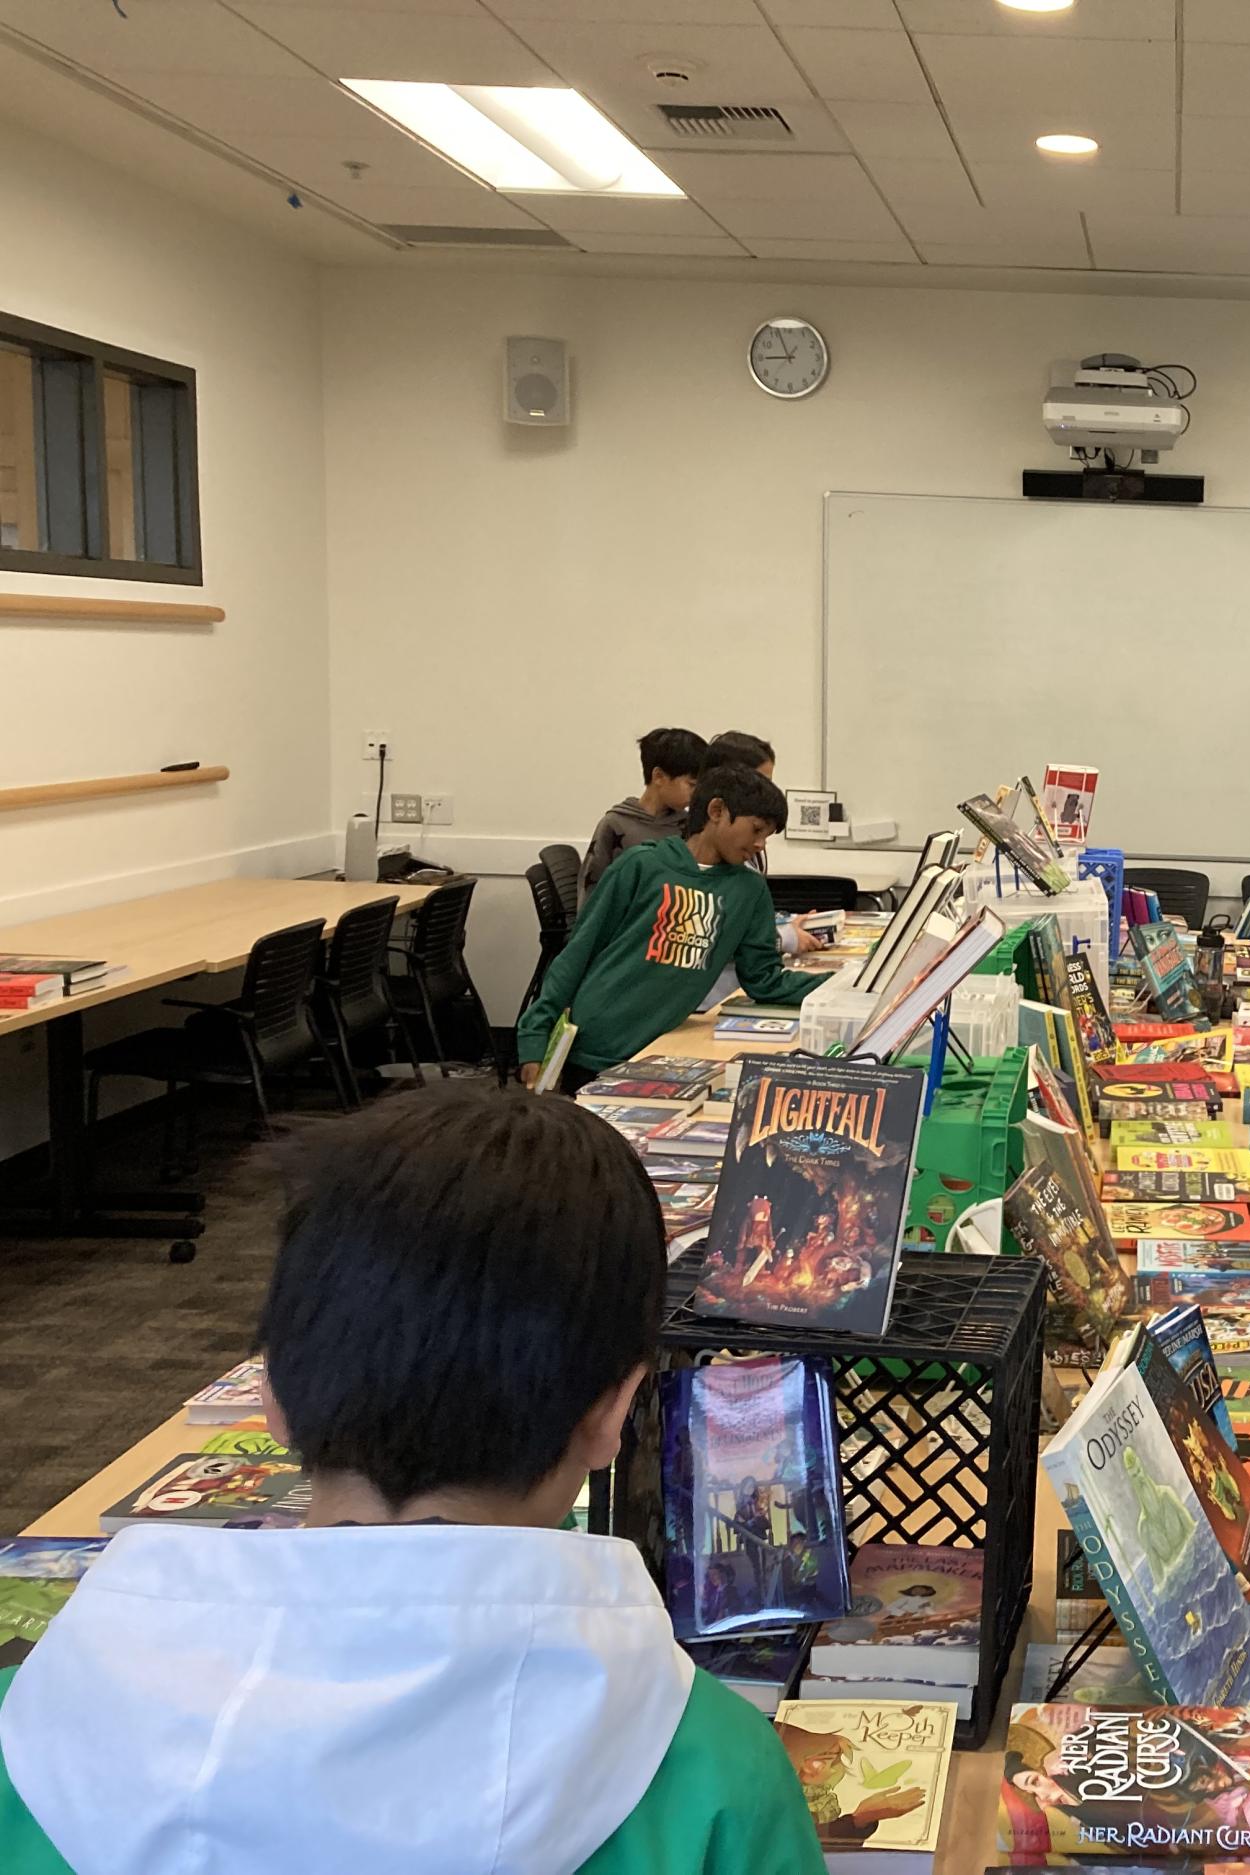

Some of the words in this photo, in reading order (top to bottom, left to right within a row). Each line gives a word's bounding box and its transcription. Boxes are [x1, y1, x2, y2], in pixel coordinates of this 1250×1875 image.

[669, 932, 710, 949] adidas
[749, 1077, 886, 1157] LIGHTFALL
[820, 1157, 841, 1168] TIMES
[1086, 1394, 1145, 1471] ODYSSEY
[1103, 1406, 1117, 1423] THE
[1082, 1535, 1169, 1706] ODYSSEY
[854, 1710, 935, 1735] Moth
[858, 1724, 932, 1750] Keeper
[1060, 1724, 1098, 1776] HER
[1078, 1706, 1144, 1802] RADIANT
[1136, 1718, 1183, 1789] CURSE
[1077, 1826, 1126, 1844] HER
[1127, 1821, 1213, 1848] RADIANT
